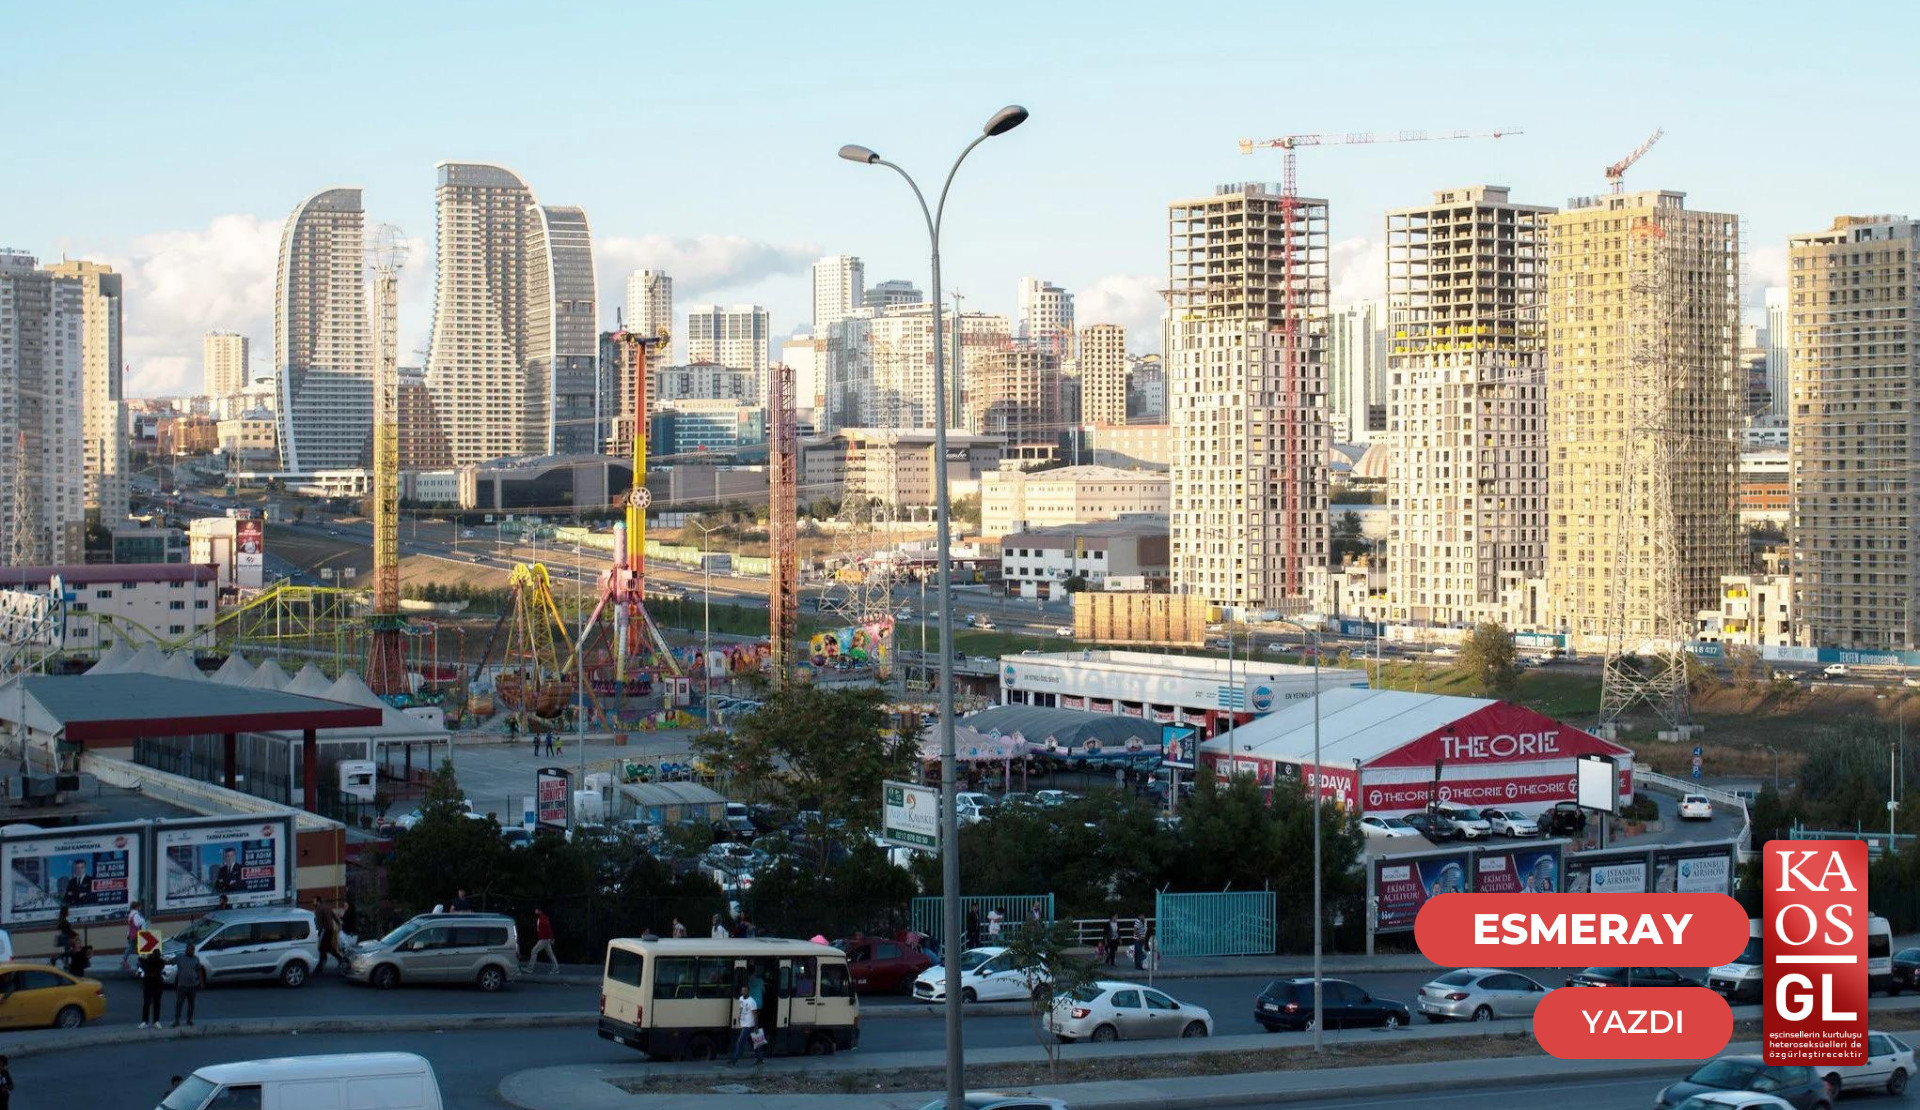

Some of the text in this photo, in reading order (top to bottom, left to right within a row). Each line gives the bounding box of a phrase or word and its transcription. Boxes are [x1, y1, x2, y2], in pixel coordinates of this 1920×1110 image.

[497, 461, 540, 470] SUNNY
[1440, 731, 1559, 758] THEORIE
[1453, 786, 1502, 798] THEORIE
[1519, 783, 1565, 795] THEORIE
[1607, 875, 1641, 885] AIRSHOW
